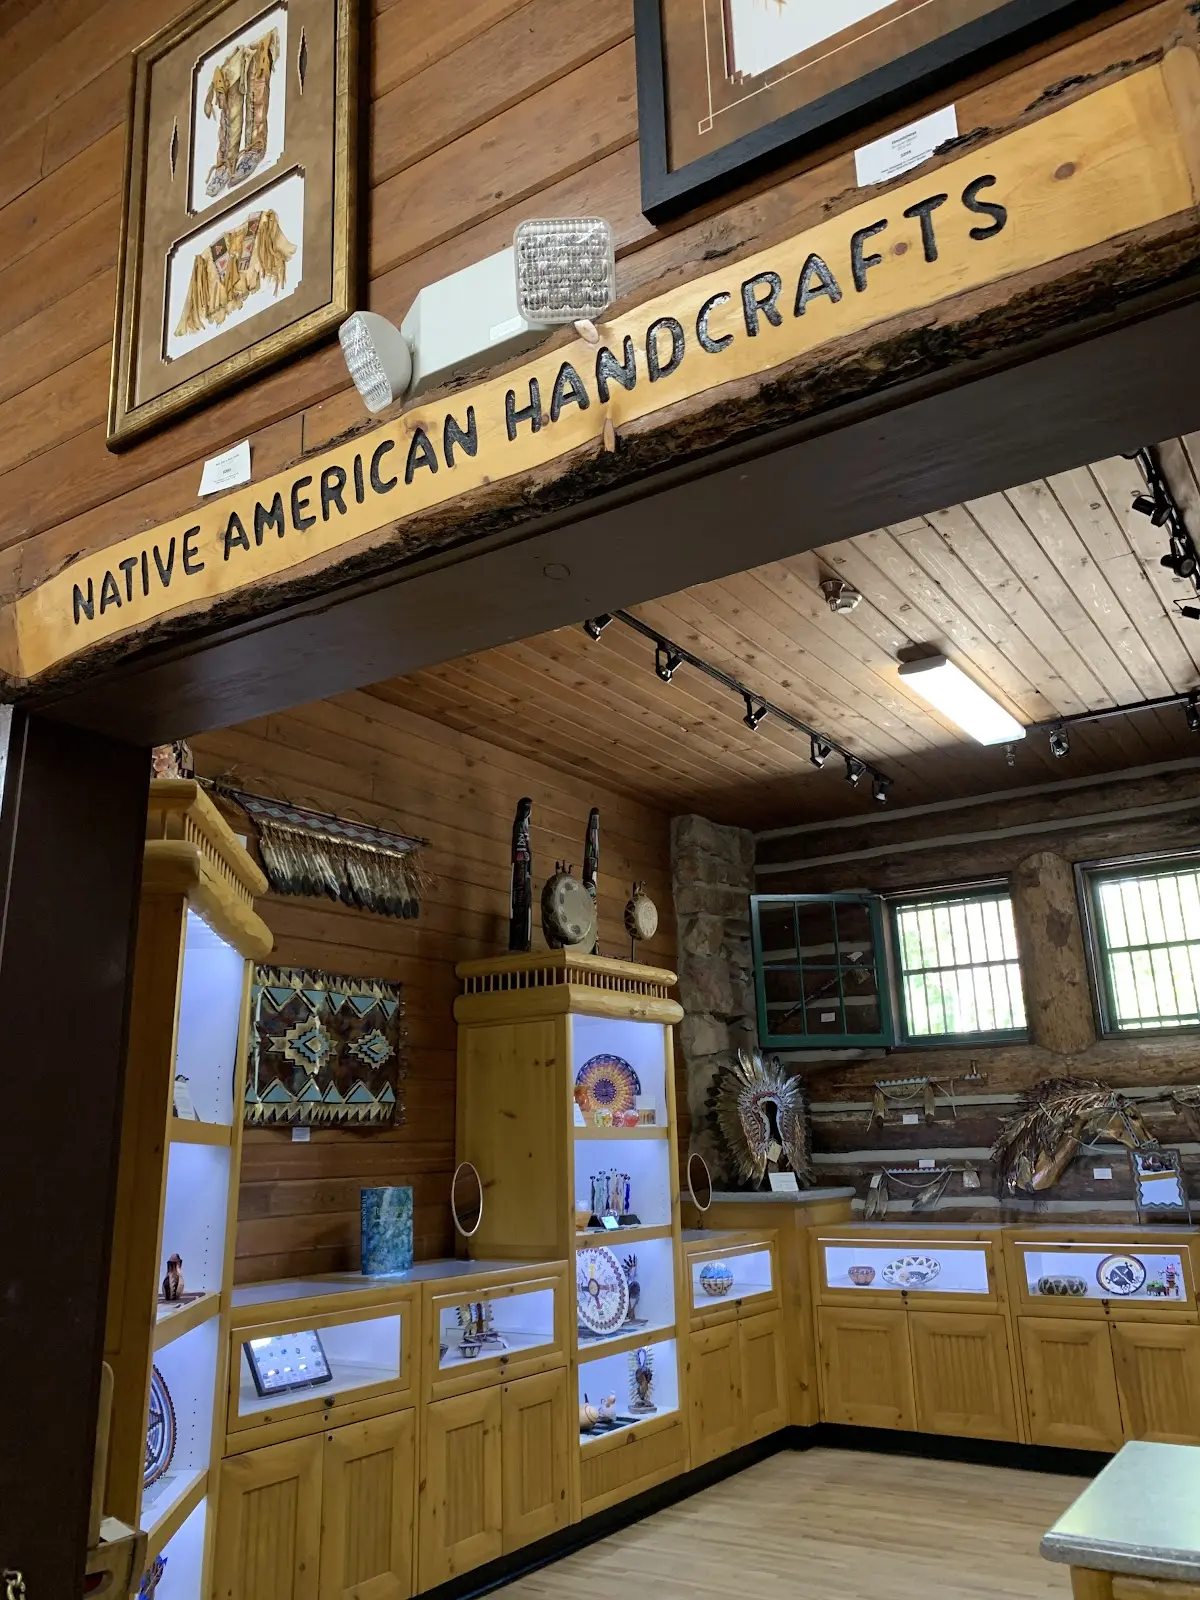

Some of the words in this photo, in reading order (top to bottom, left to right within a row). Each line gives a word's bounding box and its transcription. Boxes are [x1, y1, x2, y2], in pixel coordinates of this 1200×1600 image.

[73, 525, 205, 625] NATIVE
[224, 405, 478, 561] AMERICAN
[505, 174, 1008, 441] HANDCRAFTS
